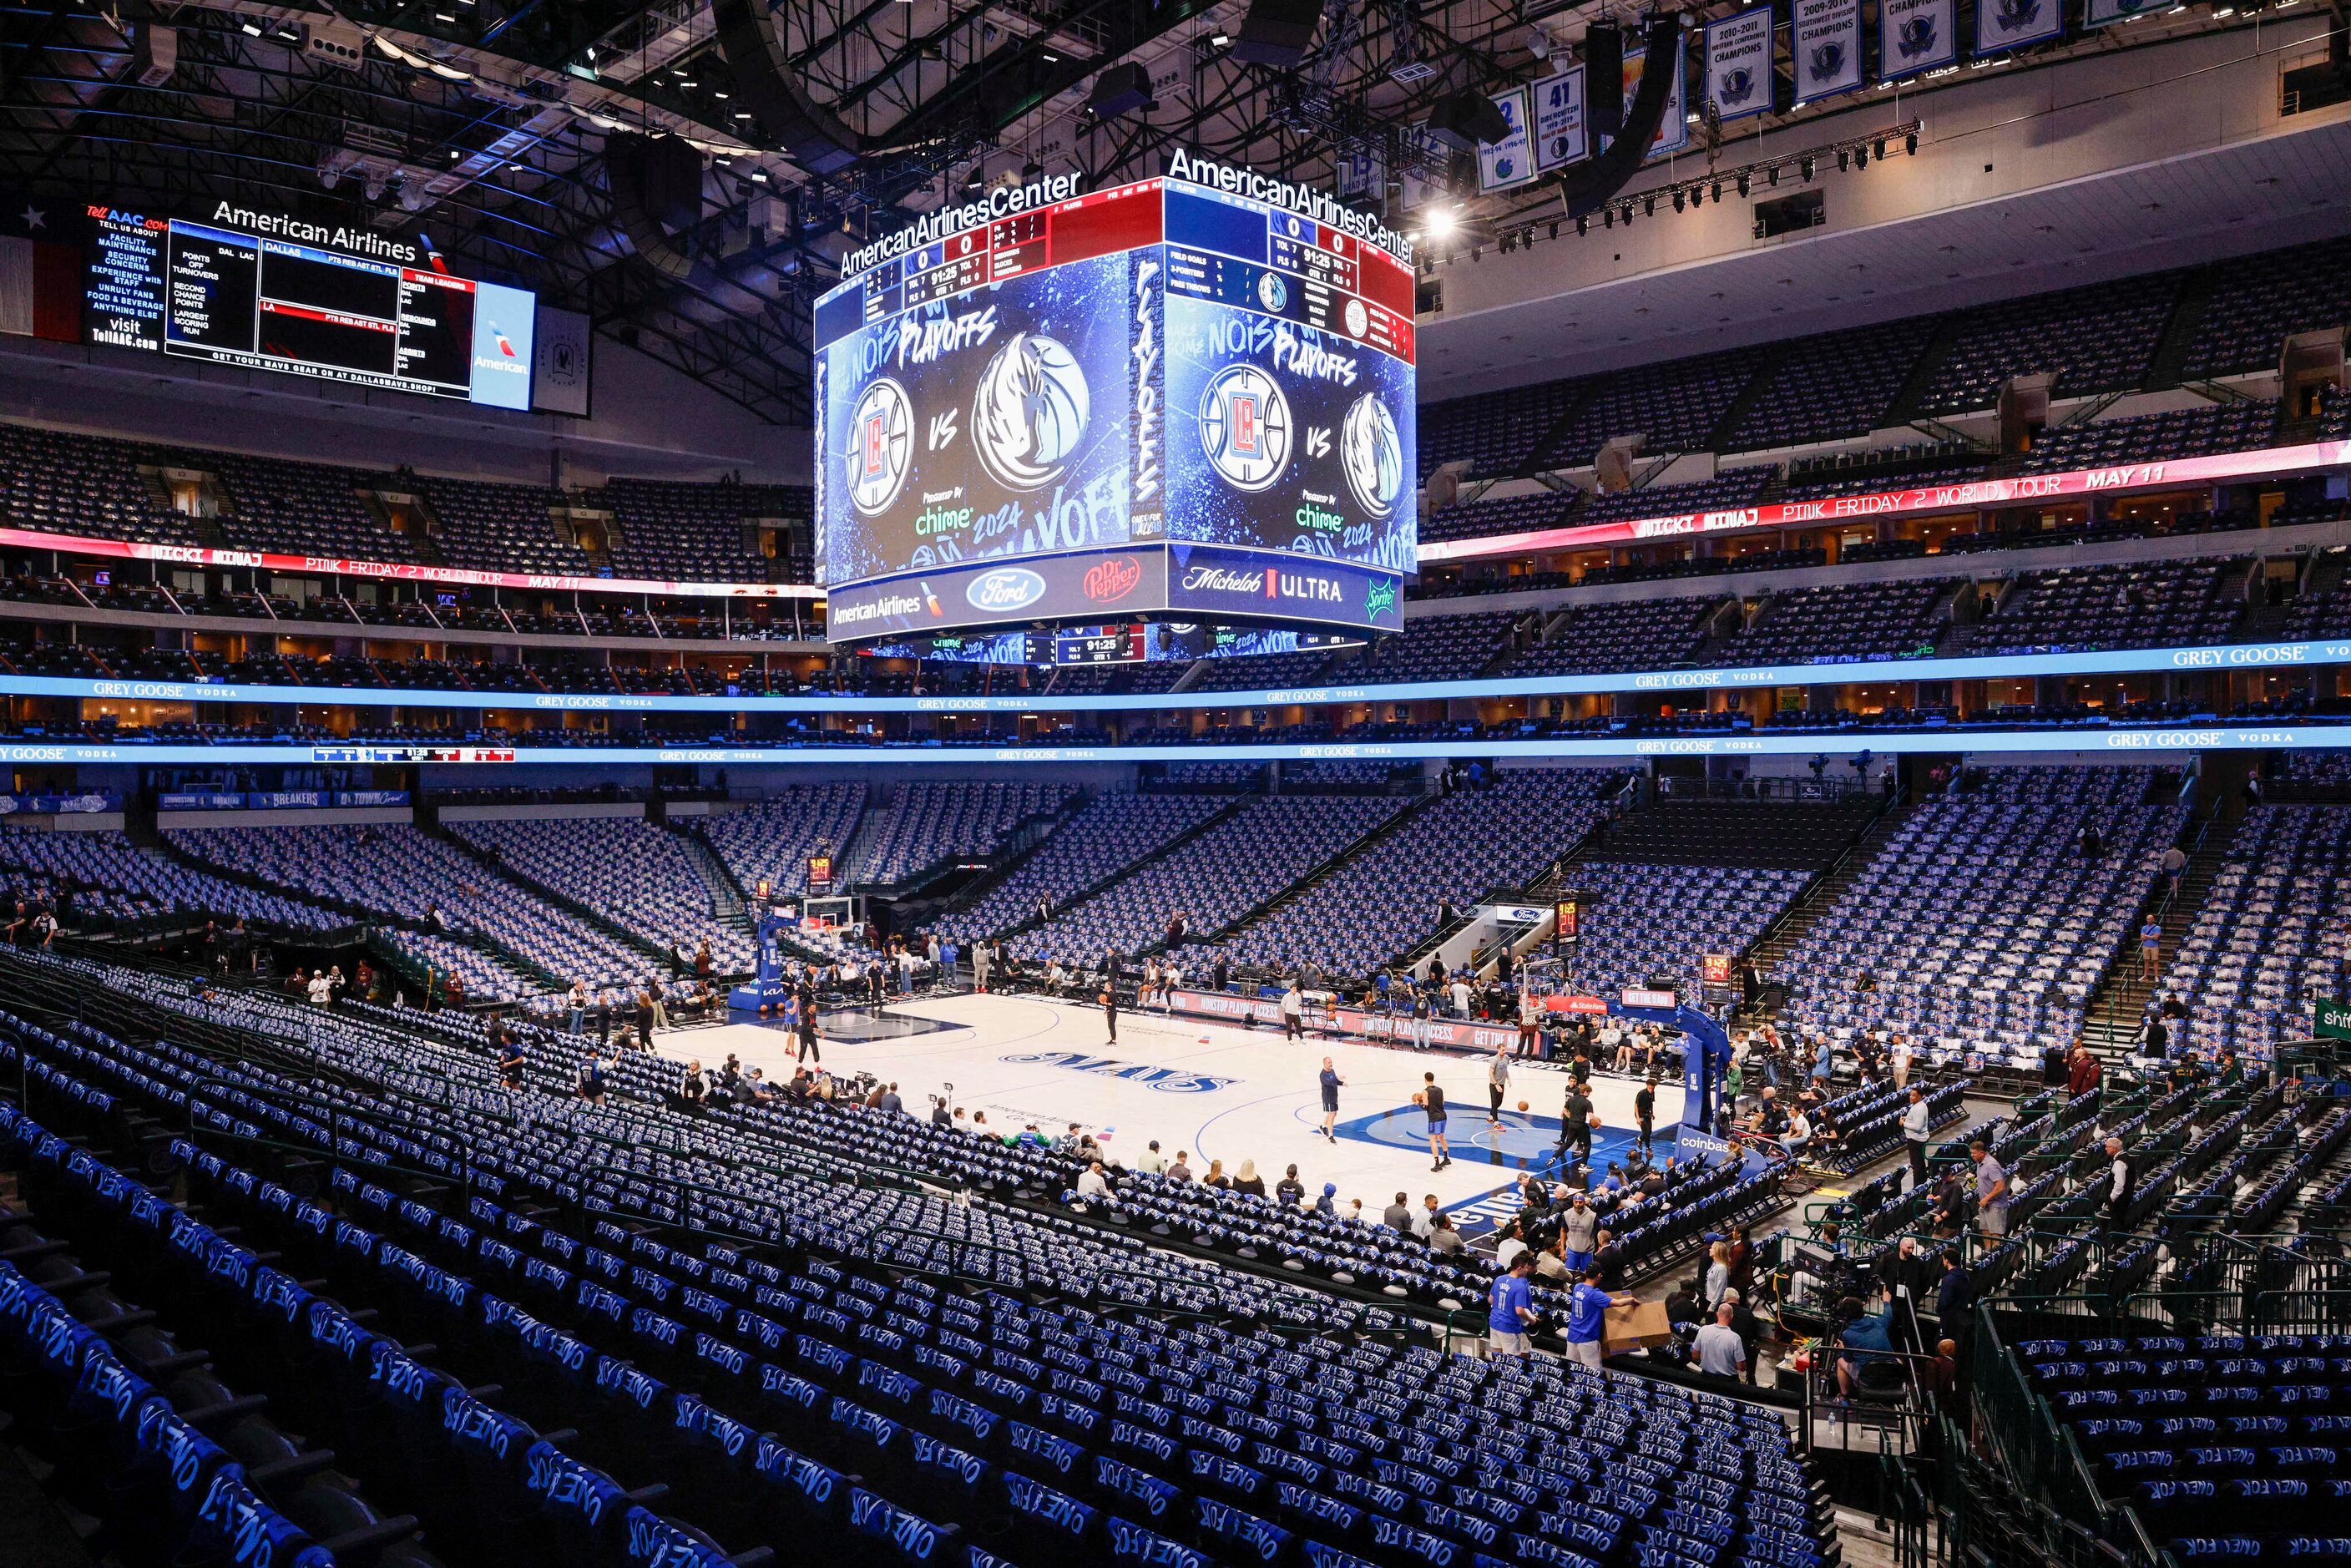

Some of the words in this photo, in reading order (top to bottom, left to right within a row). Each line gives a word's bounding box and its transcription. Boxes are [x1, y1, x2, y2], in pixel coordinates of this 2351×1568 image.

[1798, 14, 1830, 28] SOUTHWEST
[1832, 6, 1856, 20] DIVISION
[1720, 21, 1757, 40] 2010-2011
[1802, 19, 1853, 40] CHAMPIONS
[1711, 40, 1733, 51] WESTERN
[1734, 32, 1765, 45] CONFERENCE
[1715, 43, 1761, 63] CHAMPIONS
[1550, 82, 1569, 108] 41
[99, 220, 118, 230] TELL
[134, 227, 158, 238] ABOUT
[213, 200, 329, 244] American
[331, 227, 416, 262] Airlines
[1288, 217, 1299, 237] 0
[99, 238, 157, 255] MAINTENANCE
[110, 233, 146, 246] FACILITY
[961, 235, 972, 254] 0
[1277, 240, 1289, 251] TOL
[1333, 235, 1343, 252] 0
[108, 251, 148, 264] SECURITY
[182, 252, 210, 263] POINTS
[219, 248, 234, 257] DAL
[240, 252, 255, 260] LAC
[265, 243, 301, 257] DALLAS
[328, 255, 341, 265] PTS
[342, 258, 356, 268] REB
[356, 261, 370, 270] AST
[371, 264, 383, 273] STL
[385, 266, 397, 275] FLS
[918, 251, 928, 269] 0
[1170, 251, 1186, 262] FIELD
[1188, 254, 1207, 266] GOALS
[1277, 255, 1289, 267] FLS
[1304, 249, 1330, 268] 91:25
[105, 257, 149, 271] CONCERNS
[172, 266, 219, 280] TURNOVERS
[189, 261, 204, 269] OFF
[1170, 264, 1205, 278] 3-POINTERS
[92, 266, 143, 281] EXPERIENCE
[145, 275, 162, 285] with
[114, 277, 139, 287] STAFF
[931, 267, 957, 285] 91:25
[99, 283, 131, 295] UNRULY
[134, 290, 154, 299] FANS
[174, 282, 206, 293] SECOND
[174, 290, 205, 301] CHANCE
[1170, 280, 1185, 289] FREE
[1186, 282, 1211, 294] THROWS
[87, 291, 110, 301] FOOD
[121, 297, 164, 311] BEVERAGE
[175, 298, 203, 309] POINTS
[263, 302, 275, 311] LA
[94, 302, 135, 315] ANYTHING
[137, 309, 158, 319] ELSE
[174, 309, 209, 321] LARGEST
[110, 317, 140, 334] visit
[174, 317, 209, 329] SCORING
[183, 326, 200, 335] RUN
[93, 329, 157, 350] TellAAC.com
[897, 304, 997, 371] PLAYOFFS
[1273, 327, 1358, 387] PLAYOFFS
[212, 352, 231, 362] GET
[235, 354, 261, 366] YOUR
[265, 359, 289, 370] MAVS
[293, 364, 318, 375] GEAR
[321, 369, 334, 377] ON
[336, 371, 348, 379] AT
[351, 373, 436, 393] DALLASMAVS.SHOP!
[1133, 260, 1160, 501] PLAYOFFS
[929, 408, 958, 451] VS
[1307, 426, 1331, 458] VS
[923, 489, 953, 504] PRESENTED
[954, 486, 963, 498] BY
[1302, 489, 1328, 504] PRESENTED
[1329, 496, 1337, 506] BY
[1640, 515, 1694, 538] NICKI
[1704, 508, 1759, 531] MINAJ
[1782, 502, 1826, 522] PINK
[1836, 494, 1904, 518] FRIDAY
[1915, 492, 1926, 508] 2
[1937, 483, 2001, 506] WORLD
[2010, 477, 2061, 497] TOUR
[2086, 468, 2134, 488] MAY
[2141, 465, 2164, 483] 11
[915, 507, 970, 536] chime
[973, 501, 1024, 545] 2024
[1296, 503, 1342, 532] chime
[1343, 523, 1374, 549] 2024
[152, 545, 204, 563] NICKI
[212, 550, 263, 567] MINAJ
[306, 557, 341, 572] PINK
[349, 561, 400, 577] FRIDAY
[408, 566, 417, 578] 2
[424, 567, 464, 583] WORLD
[472, 572, 502, 585] TOUR
[528, 576, 561, 588] MAY
[564, 578, 579, 589] 11
[1102, 559, 1122, 577] Dr
[981, 575, 1026, 604] Ford
[1089, 564, 1136, 602] Pepper
[1182, 567, 1264, 592] Michelob
[1282, 574, 1342, 602] ULTRA
[1368, 590, 1392, 608] Sprite
[833, 602, 877, 625] American
[877, 595, 920, 619] Airlines
[2173, 648, 2227, 666] GREY
[2230, 646, 2304, 665] GOOSE
[1636, 675, 1670, 688] GREY
[1672, 673, 1721, 686] GOOSE
[1733, 672, 1774, 681] VODKA
[94, 683, 131, 696] GREY
[134, 684, 183, 697] GOOSE
[196, 688, 237, 697] VODKA
[2108, 733, 2153, 748] GREY
[2157, 732, 2220, 746] GOOSE
[2239, 733, 2293, 742] VODKA
[273, 793, 318, 807] BREAKERS
[1517, 909, 1537, 919] Ford
[1560, 914, 1574, 934] 24
[1710, 967, 1724, 978] 24
[1628, 993, 1640, 1003] GET
[1641, 994, 1652, 1004] THE
[1201, 998, 1227, 1012] NONSTOP
[1254, 1003, 1279, 1019] ACCESS.
[1475, 1031, 1489, 1045] GET
[1490, 1032, 1504, 1046] THE
[998, 1052, 1246, 1093] MAVS
[1681, 1137, 1729, 1153] coinbas
